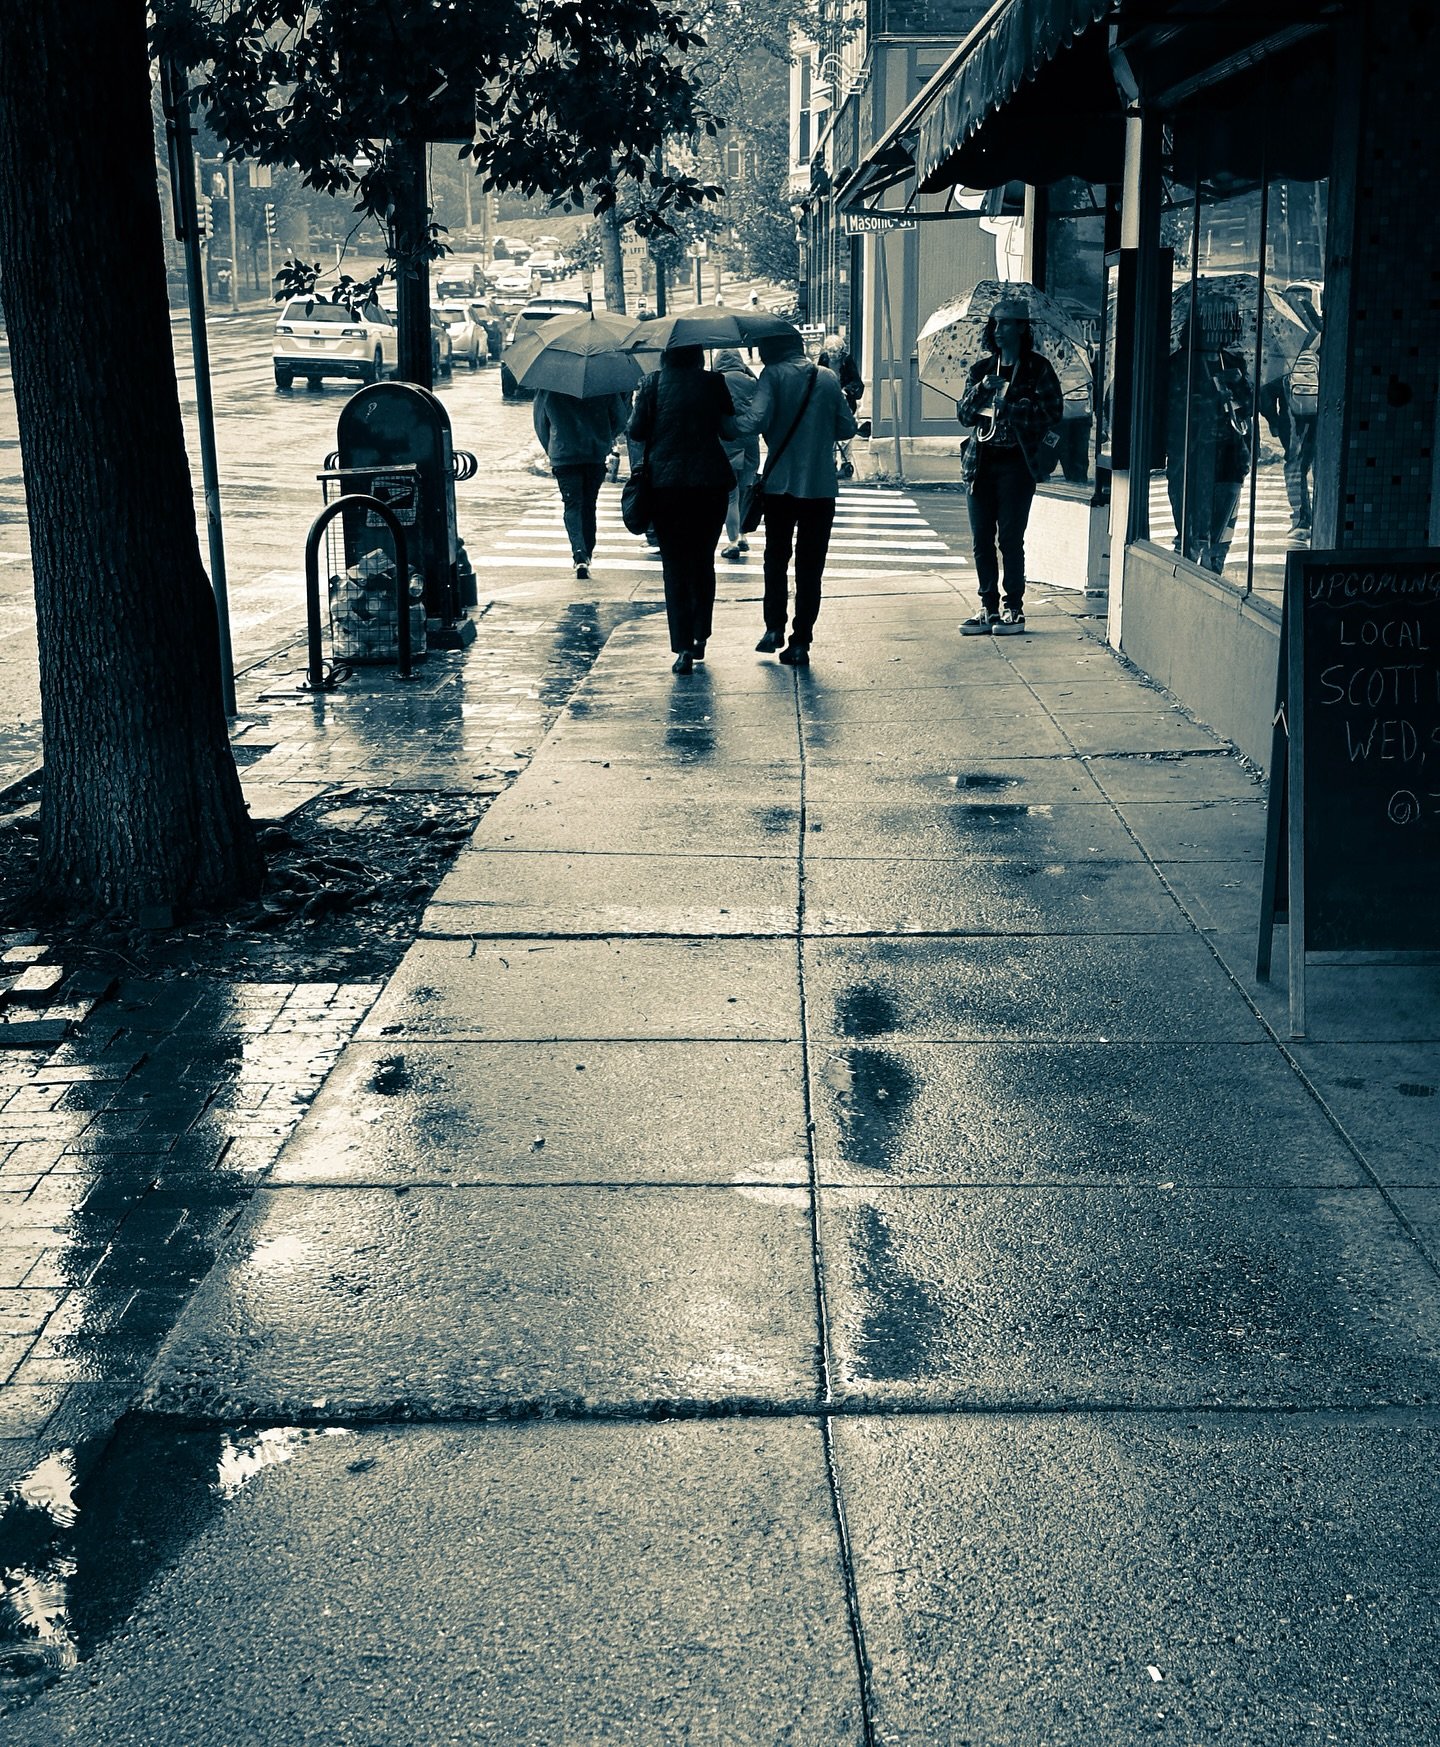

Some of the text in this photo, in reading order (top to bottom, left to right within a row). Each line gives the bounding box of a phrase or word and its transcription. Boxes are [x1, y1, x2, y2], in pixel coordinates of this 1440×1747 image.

[850, 215, 894, 231] Masonic
[1309, 571, 1440, 599] UPCOMING
[1340, 620, 1429, 650] LOCAL
[1320, 664, 1424, 707] SCOTT
